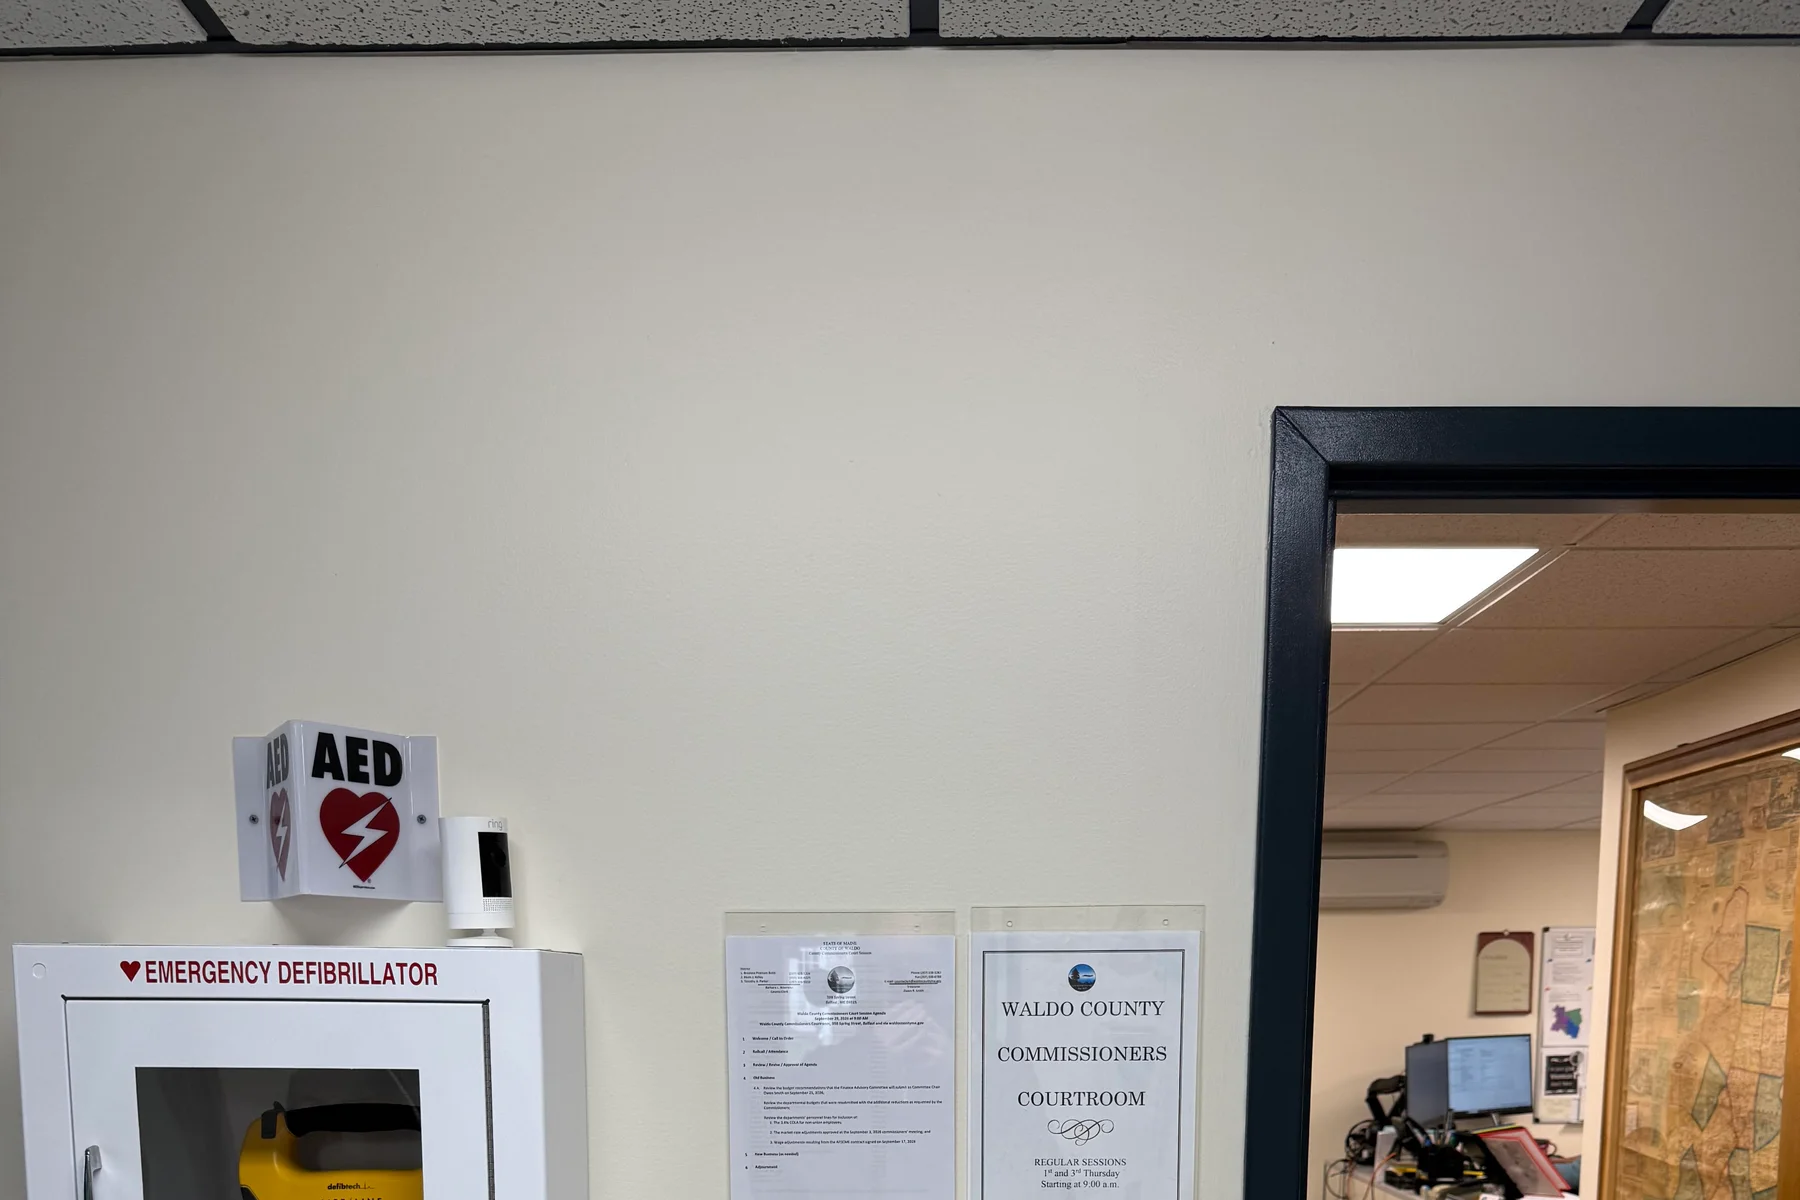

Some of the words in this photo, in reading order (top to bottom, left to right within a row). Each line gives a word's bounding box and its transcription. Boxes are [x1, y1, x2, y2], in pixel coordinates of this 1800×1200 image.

[267, 733, 289, 789] AED
[312, 732, 403, 787] AED
[488, 819, 502, 831] ring
[145, 960, 271, 984] EMERGENCY
[278, 961, 438, 986] DEFIBRILLATOR
[1001, 1001, 1074, 1016] WALDO
[1080, 1000, 1165, 1016] COUNTY
[997, 1046, 1167, 1062] COMMISSIONERS
[1017, 1091, 1146, 1106] COURTROOM
[1034, 1158, 1080, 1166] REGULAR
[1081, 1158, 1127, 1166] SESSIONS
[1044, 1168, 1053, 1177] 1st
[1054, 1169, 1069, 1177] and
[1070, 1168, 1082, 1177] 3rd
[1083, 1169, 1120, 1179] Thursday
[327, 1182, 361, 1190] defibtech
[1041, 1180, 1072, 1190] Starting
